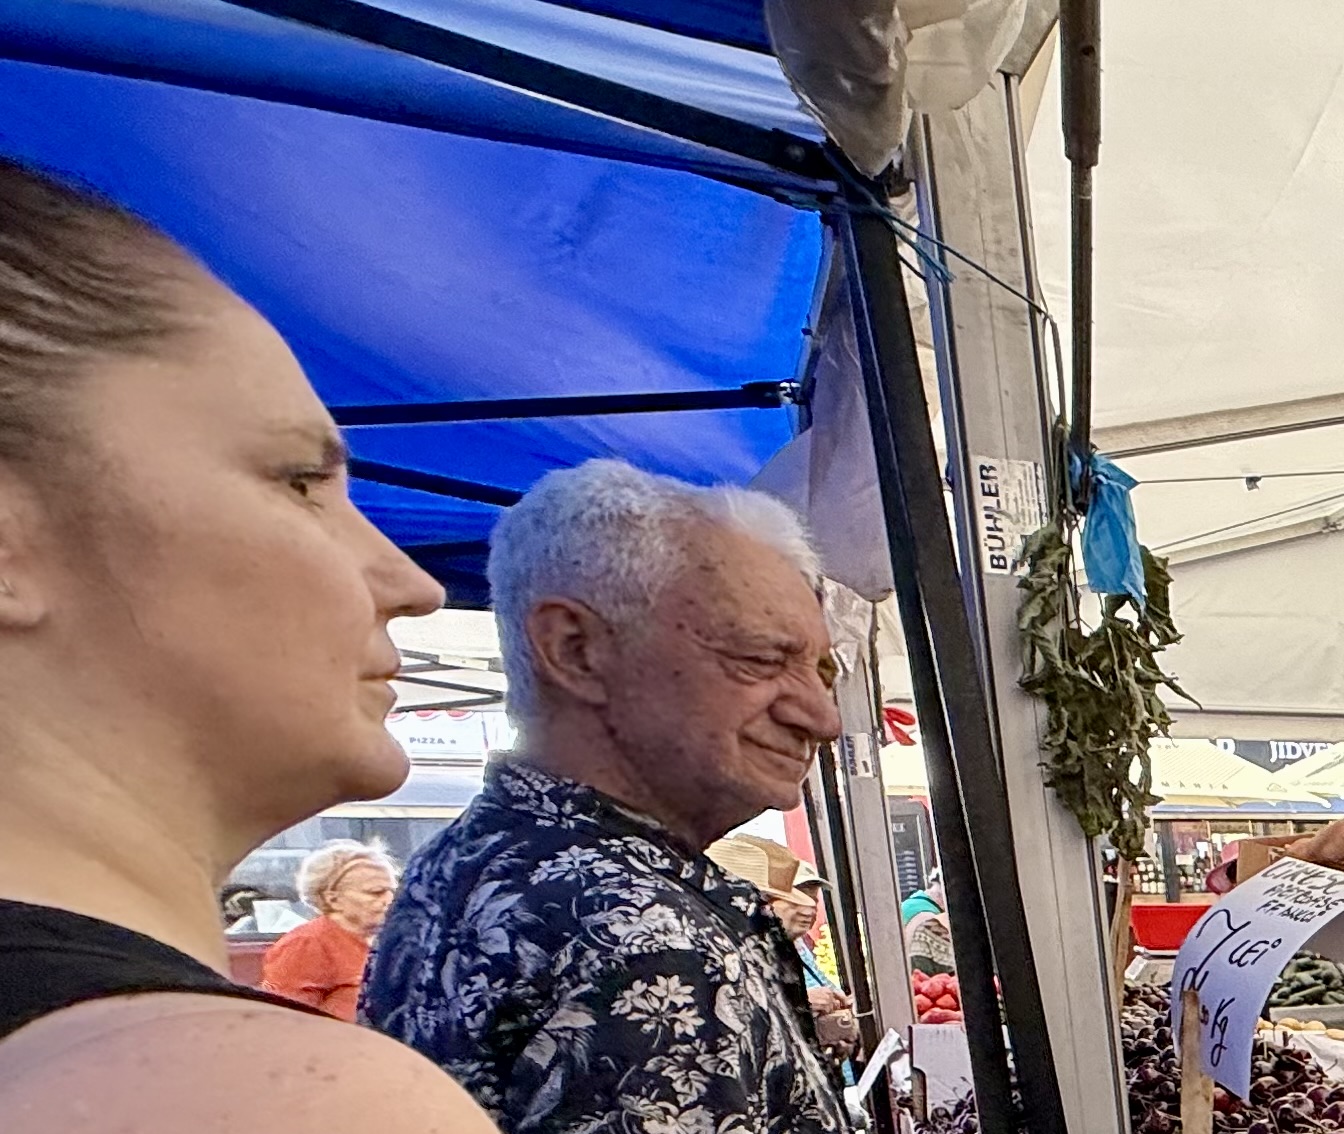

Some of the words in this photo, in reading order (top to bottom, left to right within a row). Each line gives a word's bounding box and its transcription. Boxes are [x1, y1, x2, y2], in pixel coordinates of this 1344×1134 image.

[979, 463, 1008, 570] BÜHLER
[409, 737, 445, 745] PIZZA
[1269, 740, 1333, 763] JIDVE
